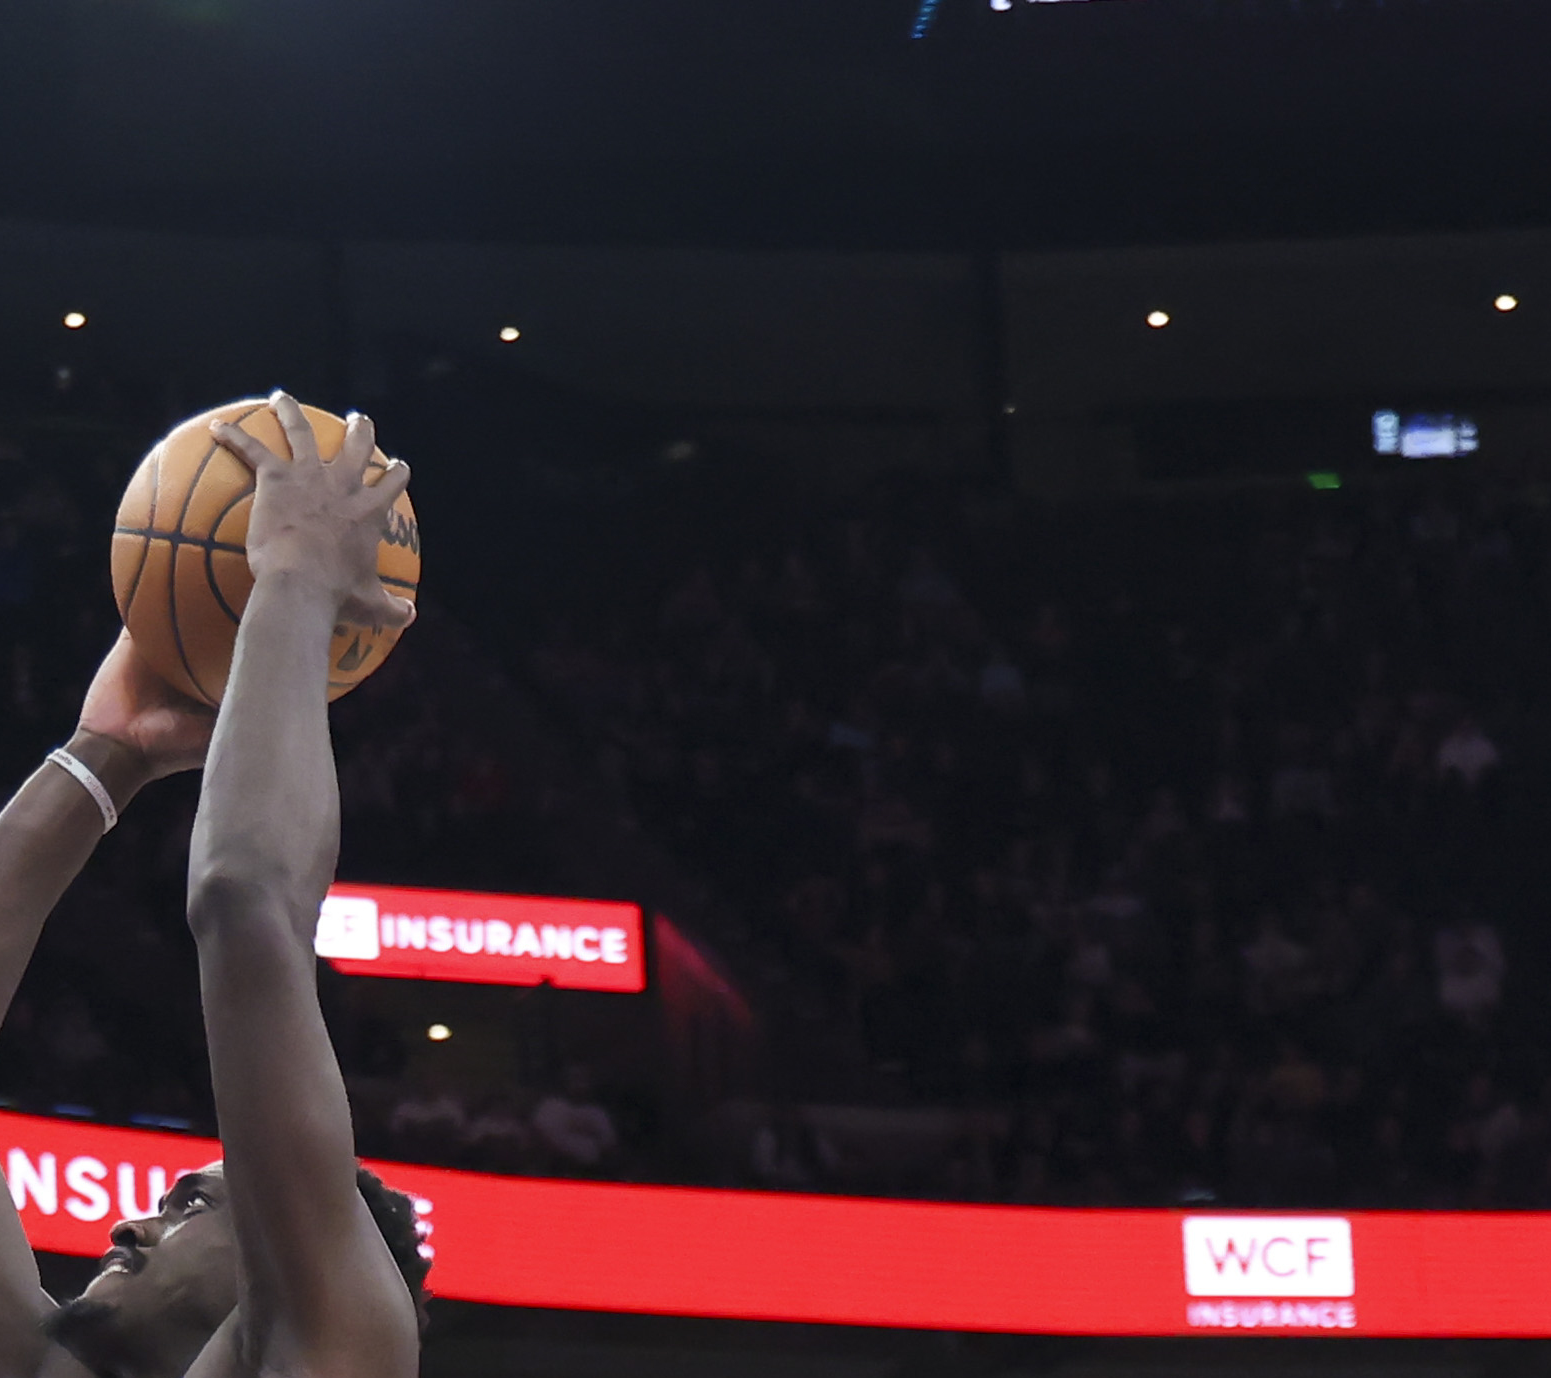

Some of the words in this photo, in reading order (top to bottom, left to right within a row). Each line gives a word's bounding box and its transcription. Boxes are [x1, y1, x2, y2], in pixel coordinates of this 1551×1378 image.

[380, 912, 629, 964] INSURANCE
[1205, 1235, 1331, 1279] WCF
[1186, 1301, 1358, 1329] INSURANCE
